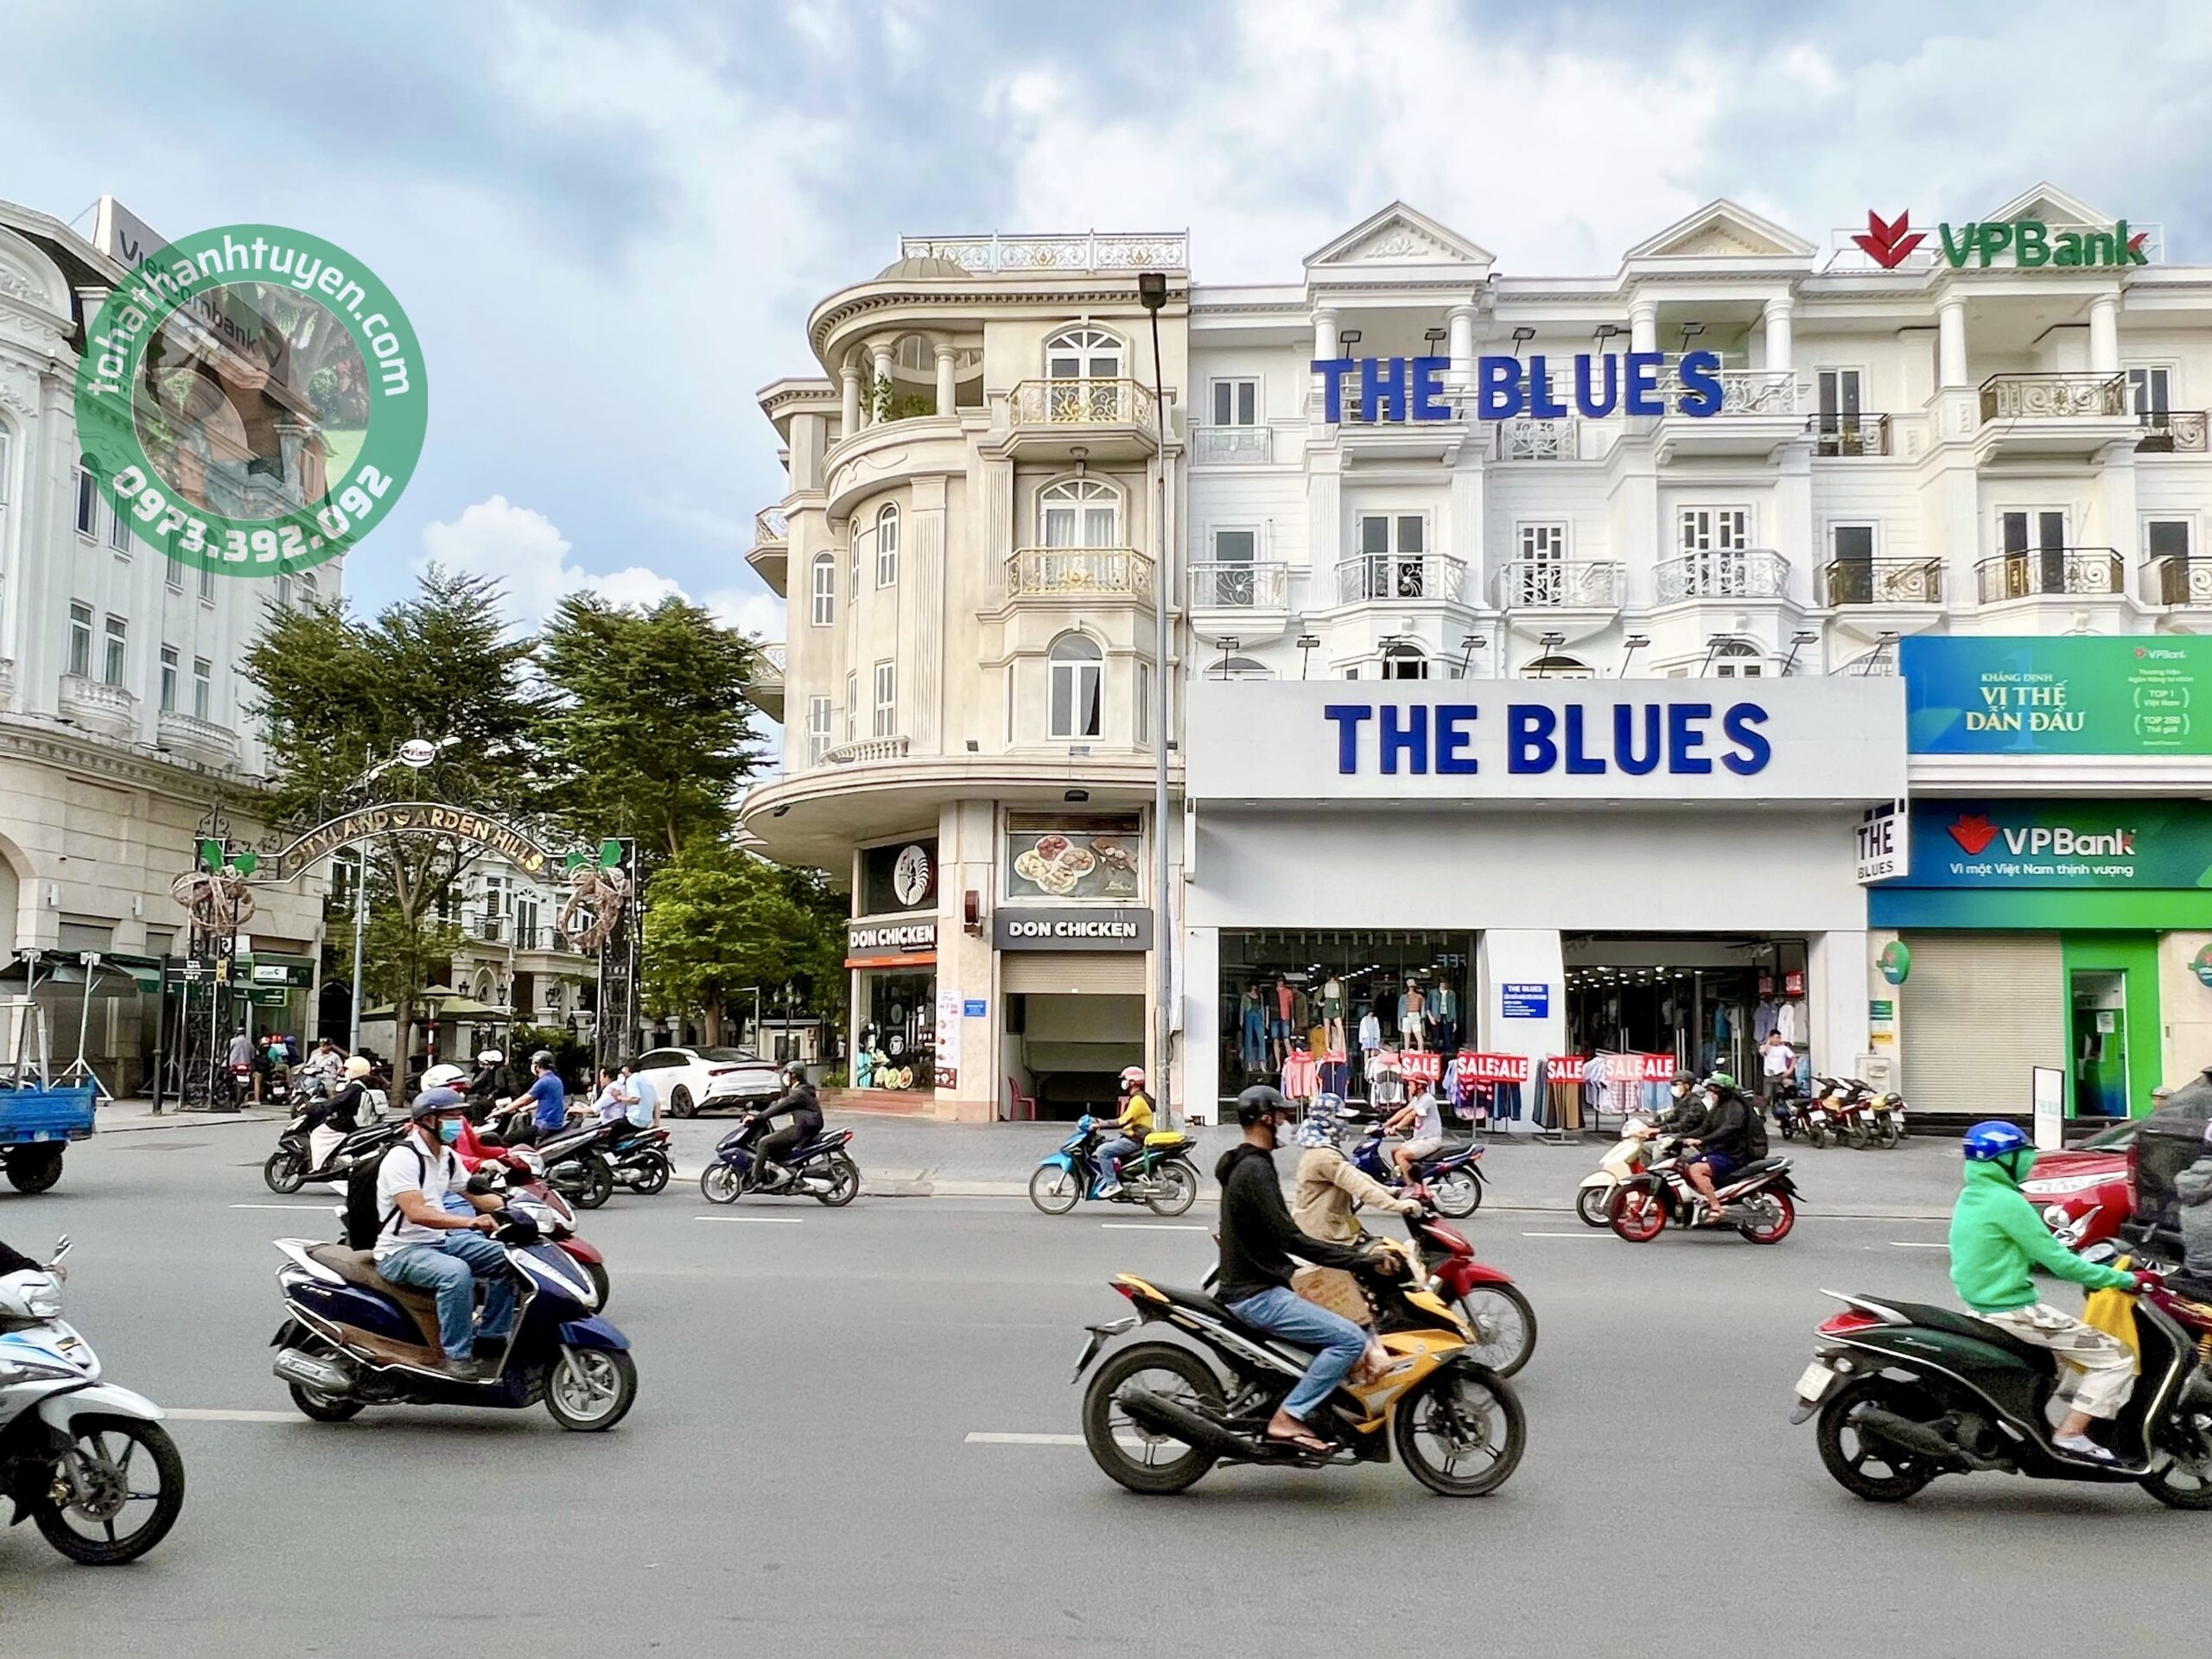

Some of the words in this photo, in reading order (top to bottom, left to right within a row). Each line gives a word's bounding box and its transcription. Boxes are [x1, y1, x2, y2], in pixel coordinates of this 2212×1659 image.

[1939, 219, 2149, 267] VPBank
[1311, 356, 1452, 423] THE
[1478, 350, 1724, 420] BLUES
[2012, 679, 2069, 706] THẾ
[1965, 705, 2022, 731] DẪN
[2028, 705, 2086, 731] ĐẦU
[1325, 704, 1478, 774] THE
[1508, 702, 1770, 776] BLUES
[286, 810, 389, 870] CITYLAND
[492, 827, 545, 872] HILLS
[1857, 819, 1894, 861] THE
[2002, 827, 2137, 856] VPBank
[1857, 860, 1894, 880] BLUES
[1950, 862, 1964, 874] Vì
[1966, 864, 1993, 877] một
[1993, 862, 2020, 877] Việt
[2024, 864, 2054, 874] Nam
[2056, 863, 2090, 877] thịnh
[2092, 865, 2133, 878] vượng
[849, 929, 877, 948] DON
[877, 924, 935, 947] CHICKEN
[1009, 921, 1052, 937] DON
[1054, 921, 1137, 937] CHICKEN
[1402, 1056, 1439, 1074] SALE
[1458, 1056, 1494, 1076] SALE
[1548, 1060, 1583, 1079] SALE
[1606, 1058, 1642, 1077] SALE
